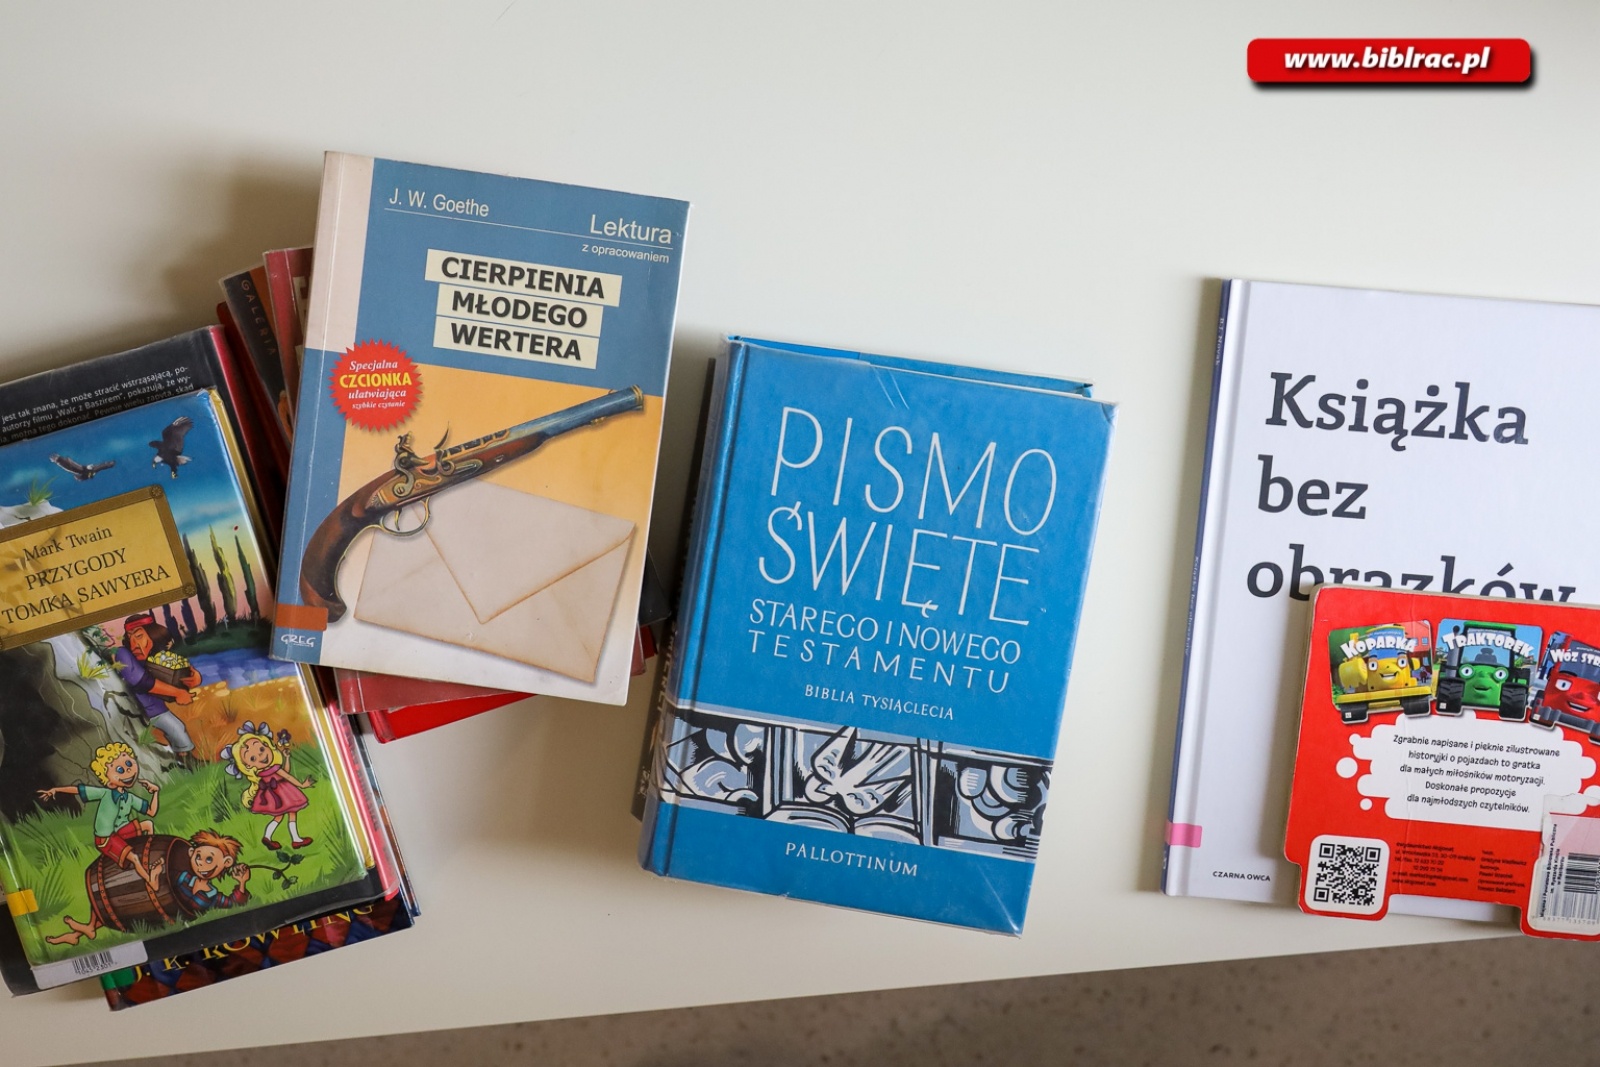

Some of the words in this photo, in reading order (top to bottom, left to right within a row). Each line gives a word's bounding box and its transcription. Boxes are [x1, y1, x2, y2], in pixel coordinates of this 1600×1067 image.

[389, 187, 403, 206] J.
[408, 190, 428, 211] W.
[433, 193, 490, 218] Goethe
[590, 213, 674, 245] Lektura
[582, 244, 588, 254] z
[592, 244, 670, 264] opracowaniem
[441, 256, 605, 299] CIERPIENIA
[452, 290, 588, 329] MŁODEGO
[451, 323, 582, 361] WERTERA
[339, 372, 412, 389] CZCIONKA
[349, 360, 398, 372] Specjalna
[2, 413, 16, 424] jest
[18, 409, 30, 418] tak
[32, 402, 58, 414] znana,
[60, 398, 70, 406] że
[71, 392, 93, 403] może
[94, 383, 120, 397] stracić
[174, 366, 188, 376] po-
[2, 420, 31, 433] autorzy
[32, 414, 53, 424] filmu
[128, 383, 164, 398] pokazują,
[166, 379, 176, 387] że
[177, 375, 191, 384] wy-
[348, 388, 406, 400] ułatwiająca
[352, 402, 377, 410] szybkie
[378, 400, 406, 410] czytanie
[1265, 371, 1530, 452] Książka
[770, 405, 1058, 537] PISMO
[1257, 454, 1369, 520] bez
[22, 540, 66, 562] Mark
[66, 527, 113, 549] Twain
[25, 548, 126, 591] PRZYGODY
[758, 501, 1041, 626] ŚWIĘTE
[2, 593, 75, 624] TOMKA
[77, 564, 171, 604] SAWYERA
[280, 634, 316, 648] GREG
[750, 597, 879, 642] STAREGO
[886, 620, 892, 645] I
[900, 622, 1022, 665] NOWEGO
[1442, 632, 1534, 658] TRAKTOREK
[748, 629, 1010, 694] TESTAMENTU
[1340, 636, 1416, 659] KOPARKA
[1550, 648, 1579, 663] WÓZ
[804, 684, 856, 705] BIBLIA
[862, 694, 954, 721] TYSIĄCLECIA
[1393, 734, 1430, 744] Zgrabnie
[1431, 738, 1468, 749] napisane
[1474, 742, 1504, 752] pięknie
[1506, 745, 1560, 758] zilustrowane
[1408, 750, 1448, 764] historyjki
[1457, 755, 1500, 766] pojazdach
[1501, 759, 1510, 768] to
[1512, 761, 1541, 770] gratka
[1400, 765, 1412, 773] dla
[1414, 766, 1444, 777] małych
[1446, 769, 1494, 780] miłośników
[1494, 774, 1546, 788] motoryzacji.
[1425, 781, 1469, 793] Doskonałe
[1470, 785, 1517, 798] propozycje
[1406, 794, 1420, 802] dla
[1421, 795, 1478, 809] najmłodszych
[1480, 802, 1530, 814] czytelników.
[785, 842, 919, 878] PALLOTTINUM
[1212, 870, 1245, 881] CZARNA
[1246, 873, 1272, 882] OWCA
[162, 954, 191, 972] K.
